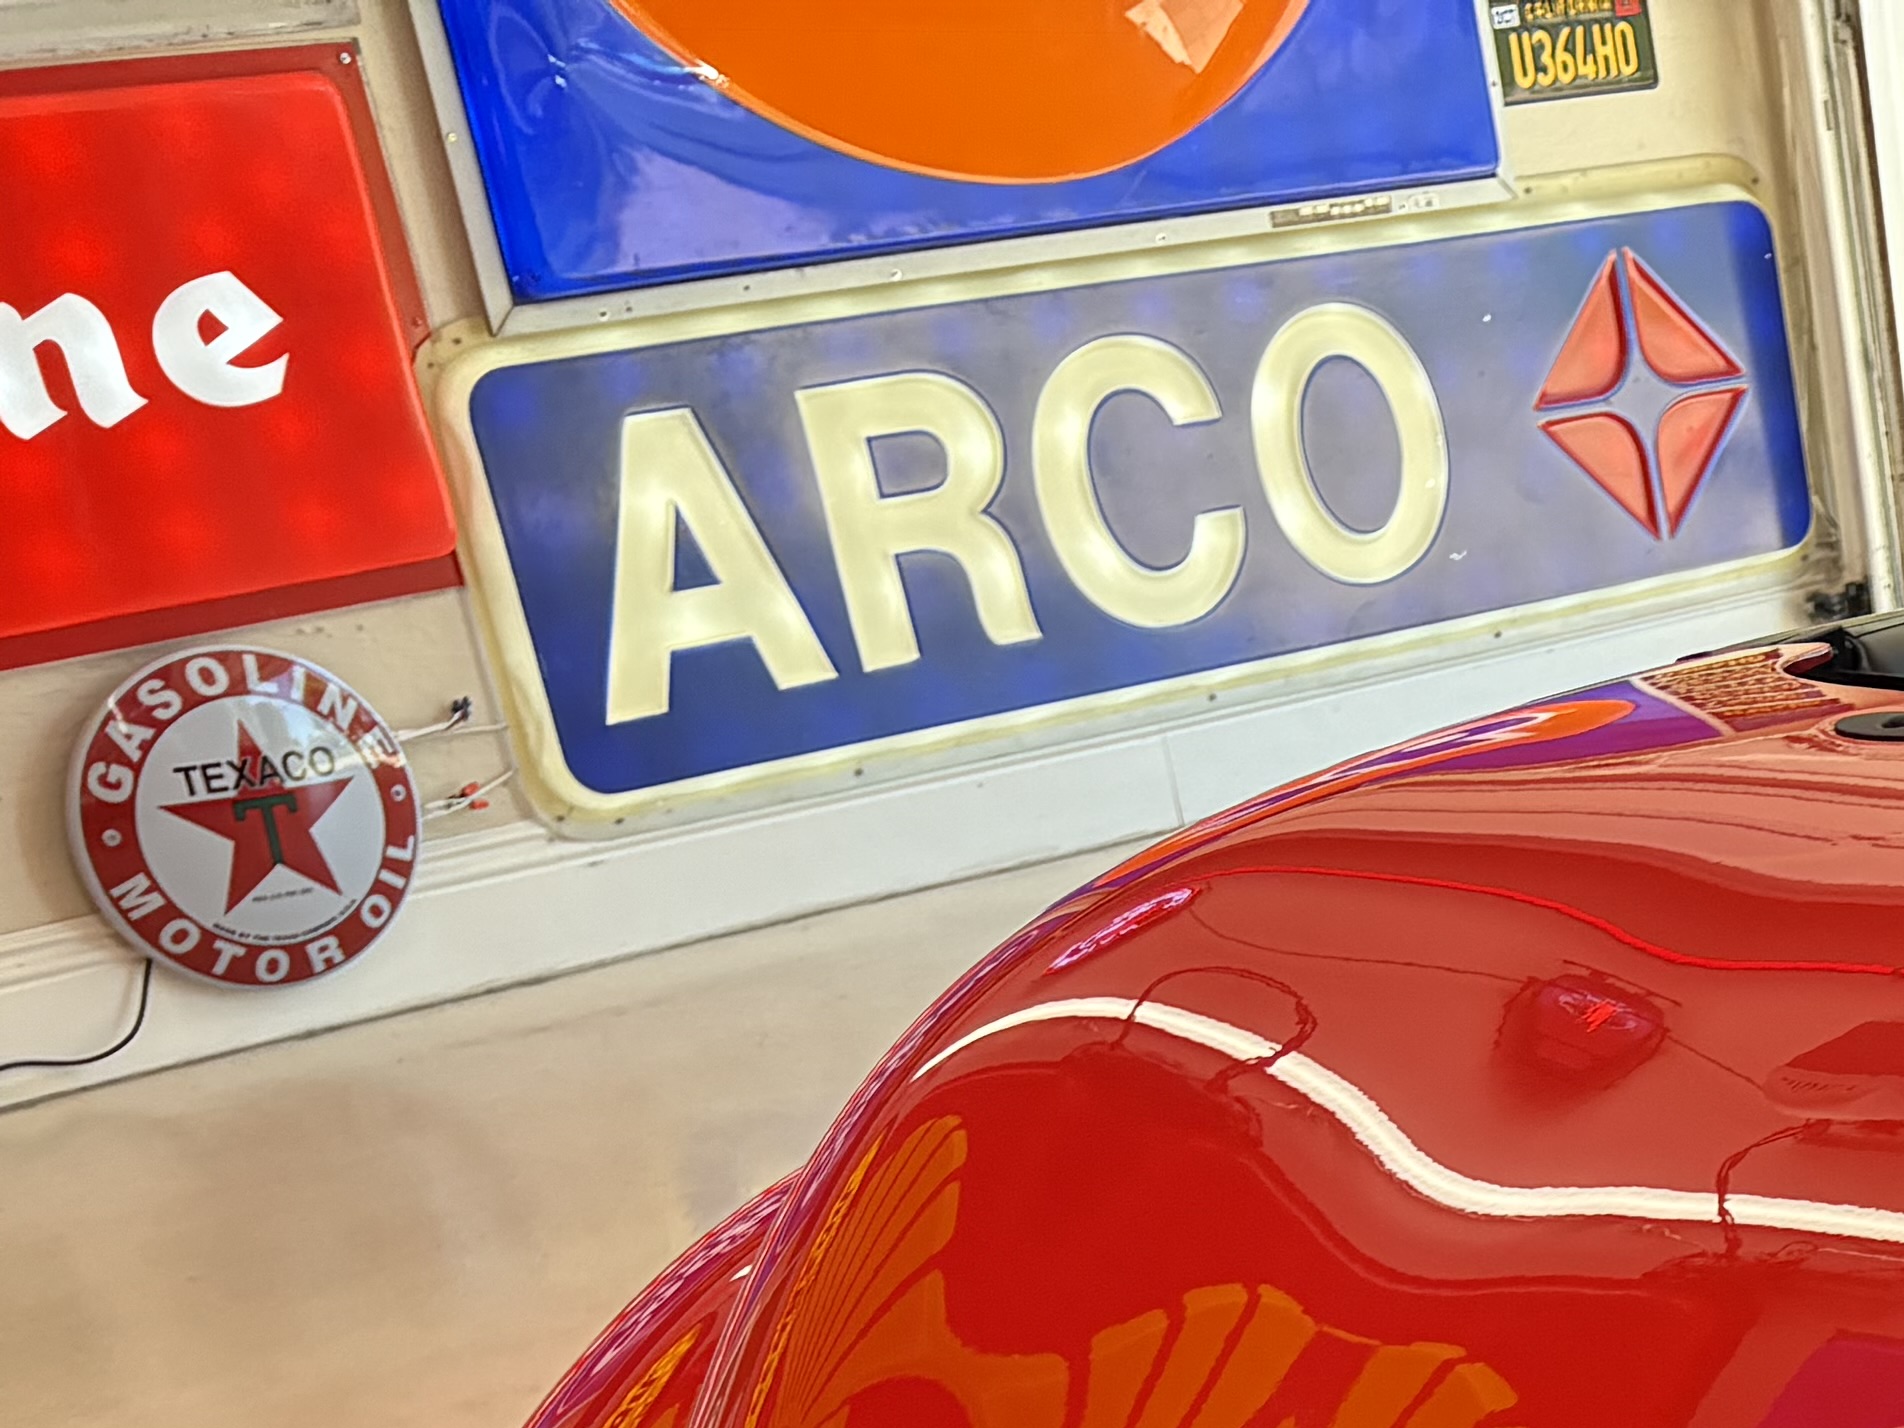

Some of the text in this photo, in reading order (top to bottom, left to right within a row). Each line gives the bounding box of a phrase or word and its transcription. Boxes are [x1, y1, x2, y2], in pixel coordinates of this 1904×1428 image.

[605, 301, 1450, 727] ARCO
[86, 653, 406, 804] GASOLINE
[172, 746, 337, 797] TEXACO
[231, 793, 299, 866] T
[109, 871, 347, 983] MOTOR
[360, 835, 415, 929] OIL
